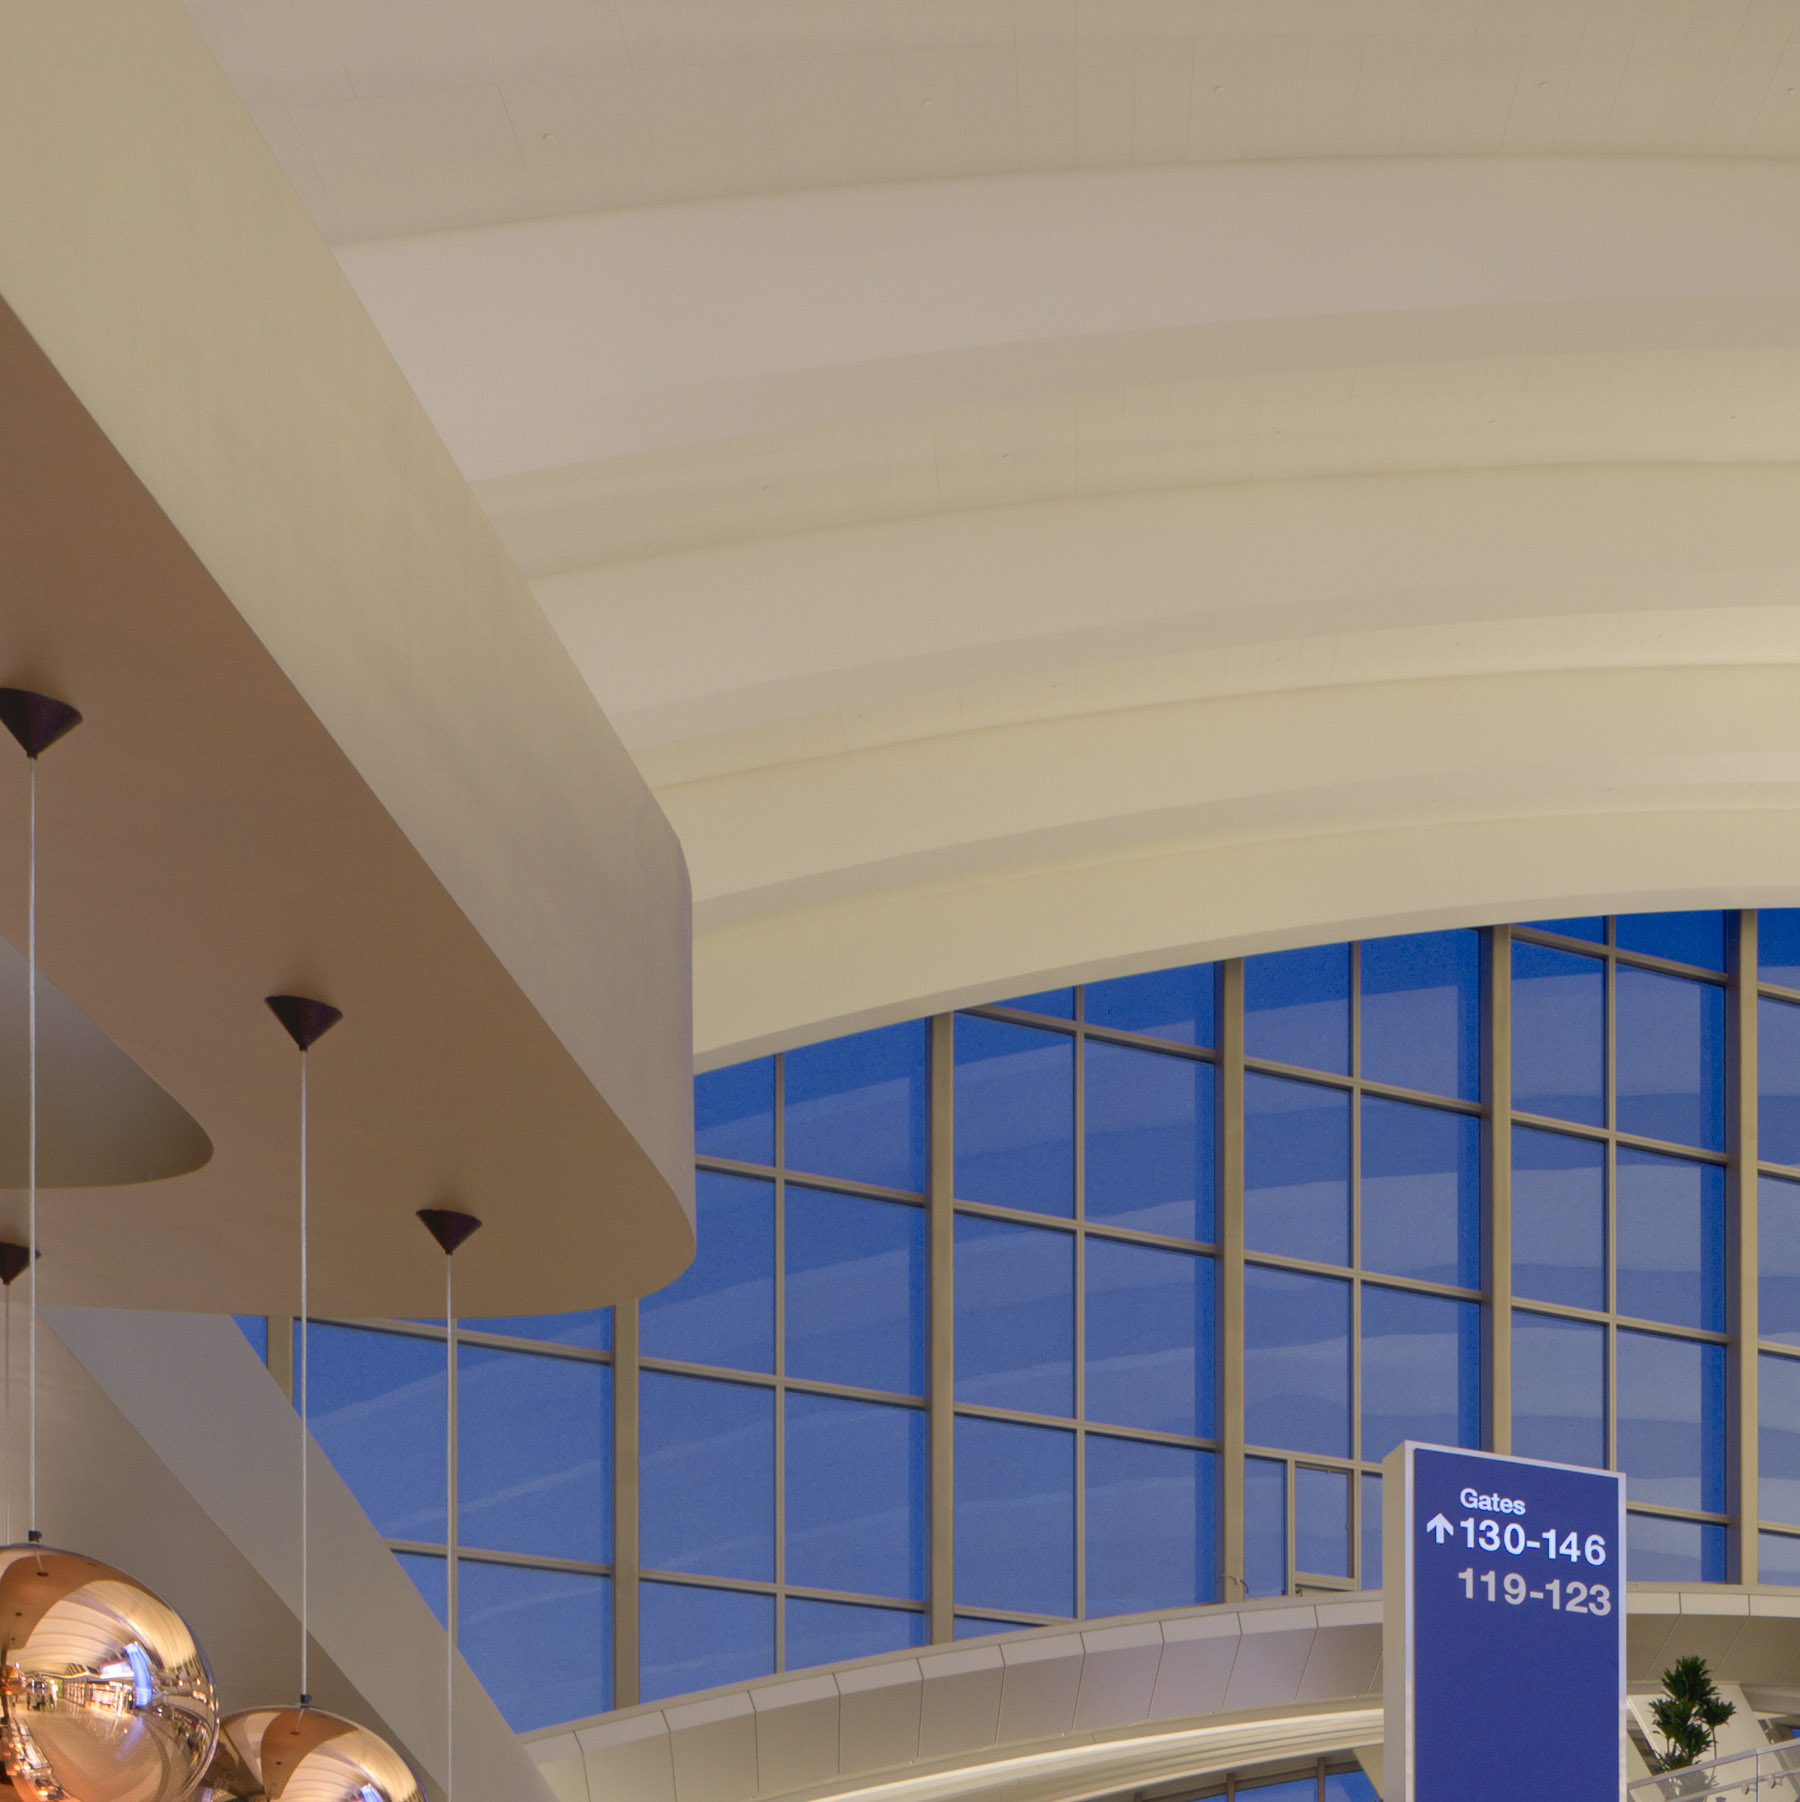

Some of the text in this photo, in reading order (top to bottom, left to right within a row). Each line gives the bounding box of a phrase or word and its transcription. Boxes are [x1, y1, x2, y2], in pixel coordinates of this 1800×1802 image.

[1460, 1487, 1526, 1516] Gates
[1459, 1517, 1606, 1567] 130-146
[1458, 1567, 1611, 1616] 119-123
